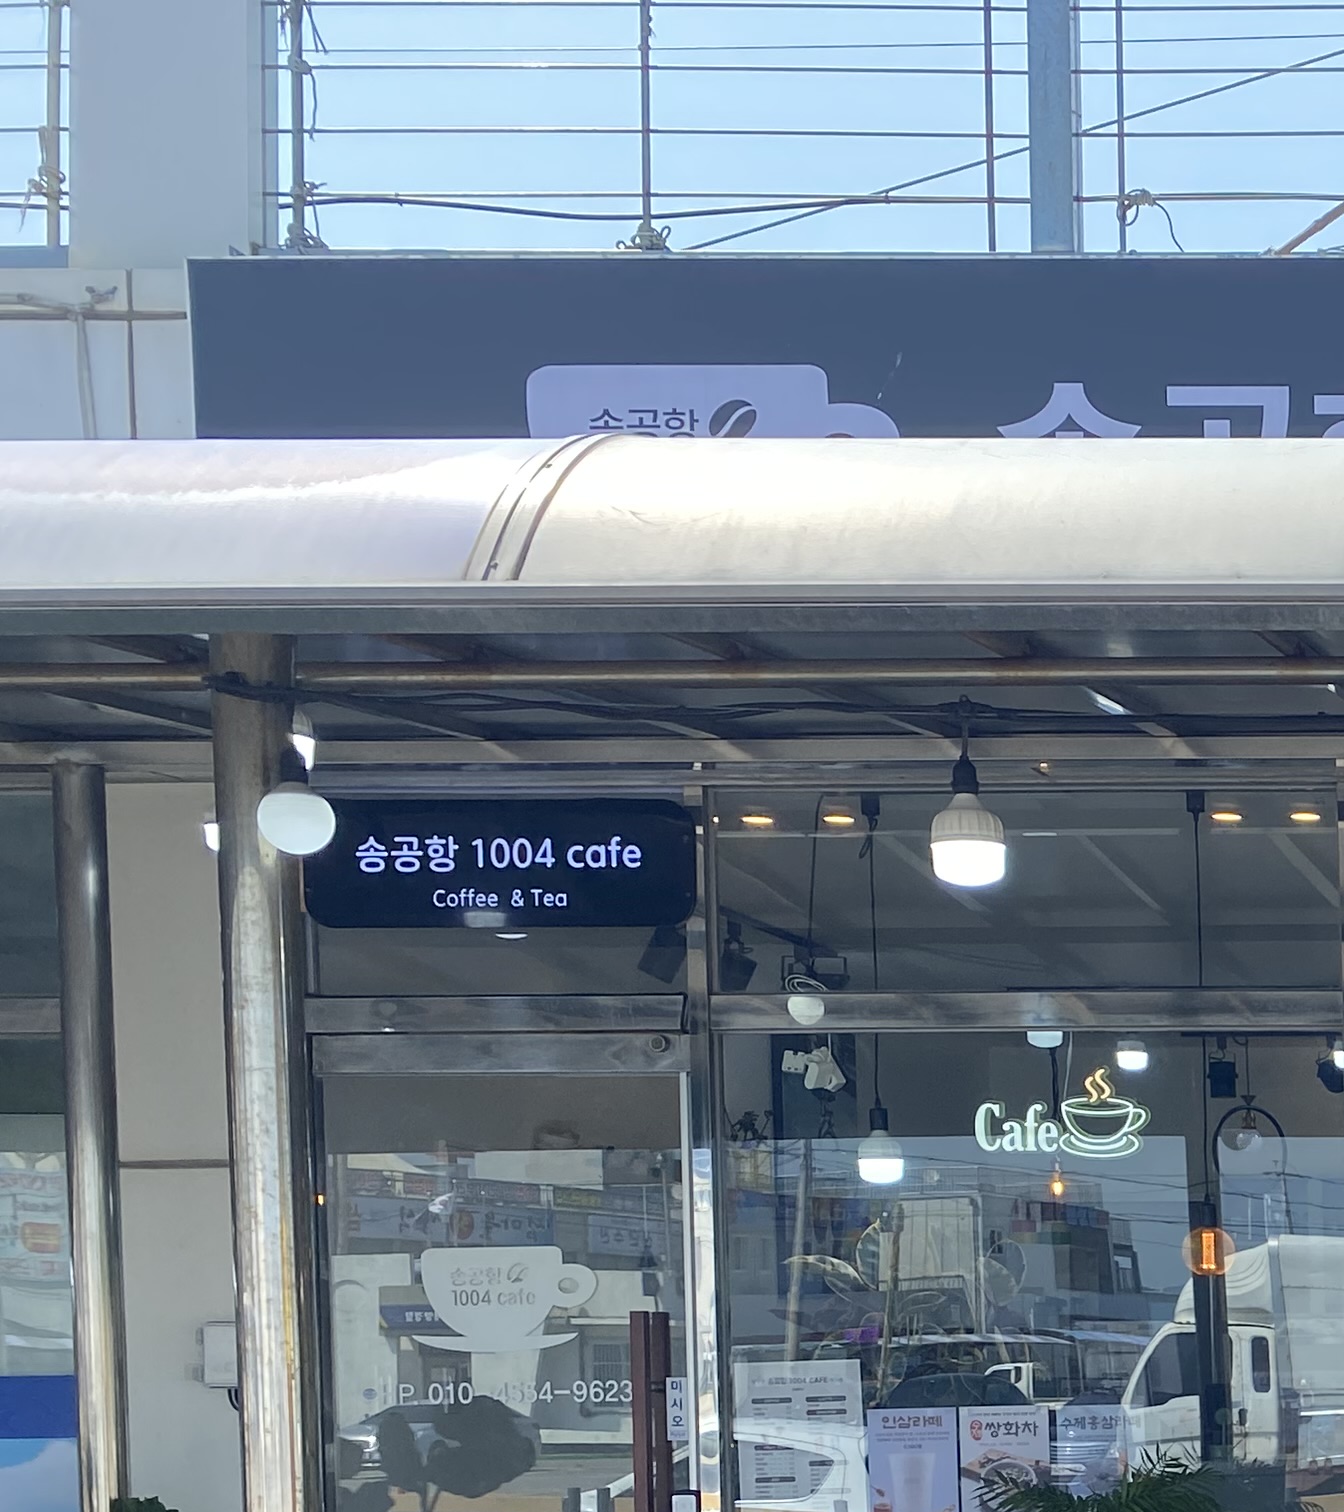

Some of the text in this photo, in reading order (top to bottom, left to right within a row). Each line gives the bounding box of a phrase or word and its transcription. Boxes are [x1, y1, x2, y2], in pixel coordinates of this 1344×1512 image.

[354, 834, 643, 874] 송공항 1004 cafe
[432, 888, 568, 908] Coffee & Tea
[973, 1100, 1061, 1153] Cafe
[451, 1289, 492, 1307] 1004
[670, 1379, 685, 1427] 미시오
[984, 1420, 1039, 1438] 쌍화차
